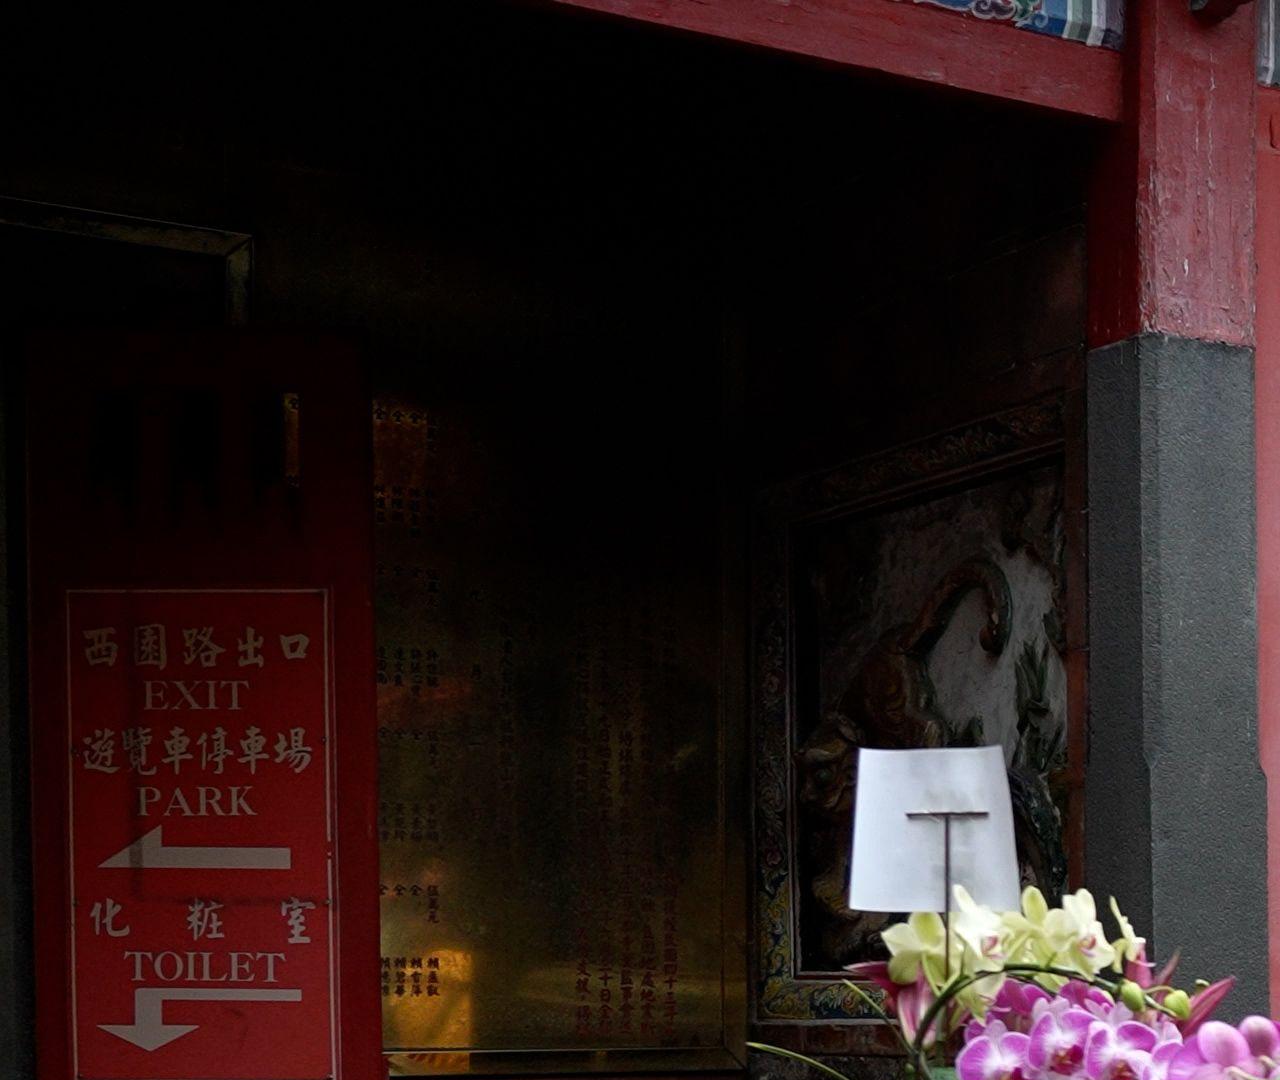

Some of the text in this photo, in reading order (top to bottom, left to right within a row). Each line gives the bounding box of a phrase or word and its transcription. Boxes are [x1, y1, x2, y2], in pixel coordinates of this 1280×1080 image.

[82, 624, 311, 670] 西園路出口
[142, 680, 250, 712] EXIT
[82, 726, 314, 776] 遊覽車停車場
[137, 786, 258, 817] PARK
[89, 898, 317, 945] 化粧室
[123, 951, 287, 983] TOILET
